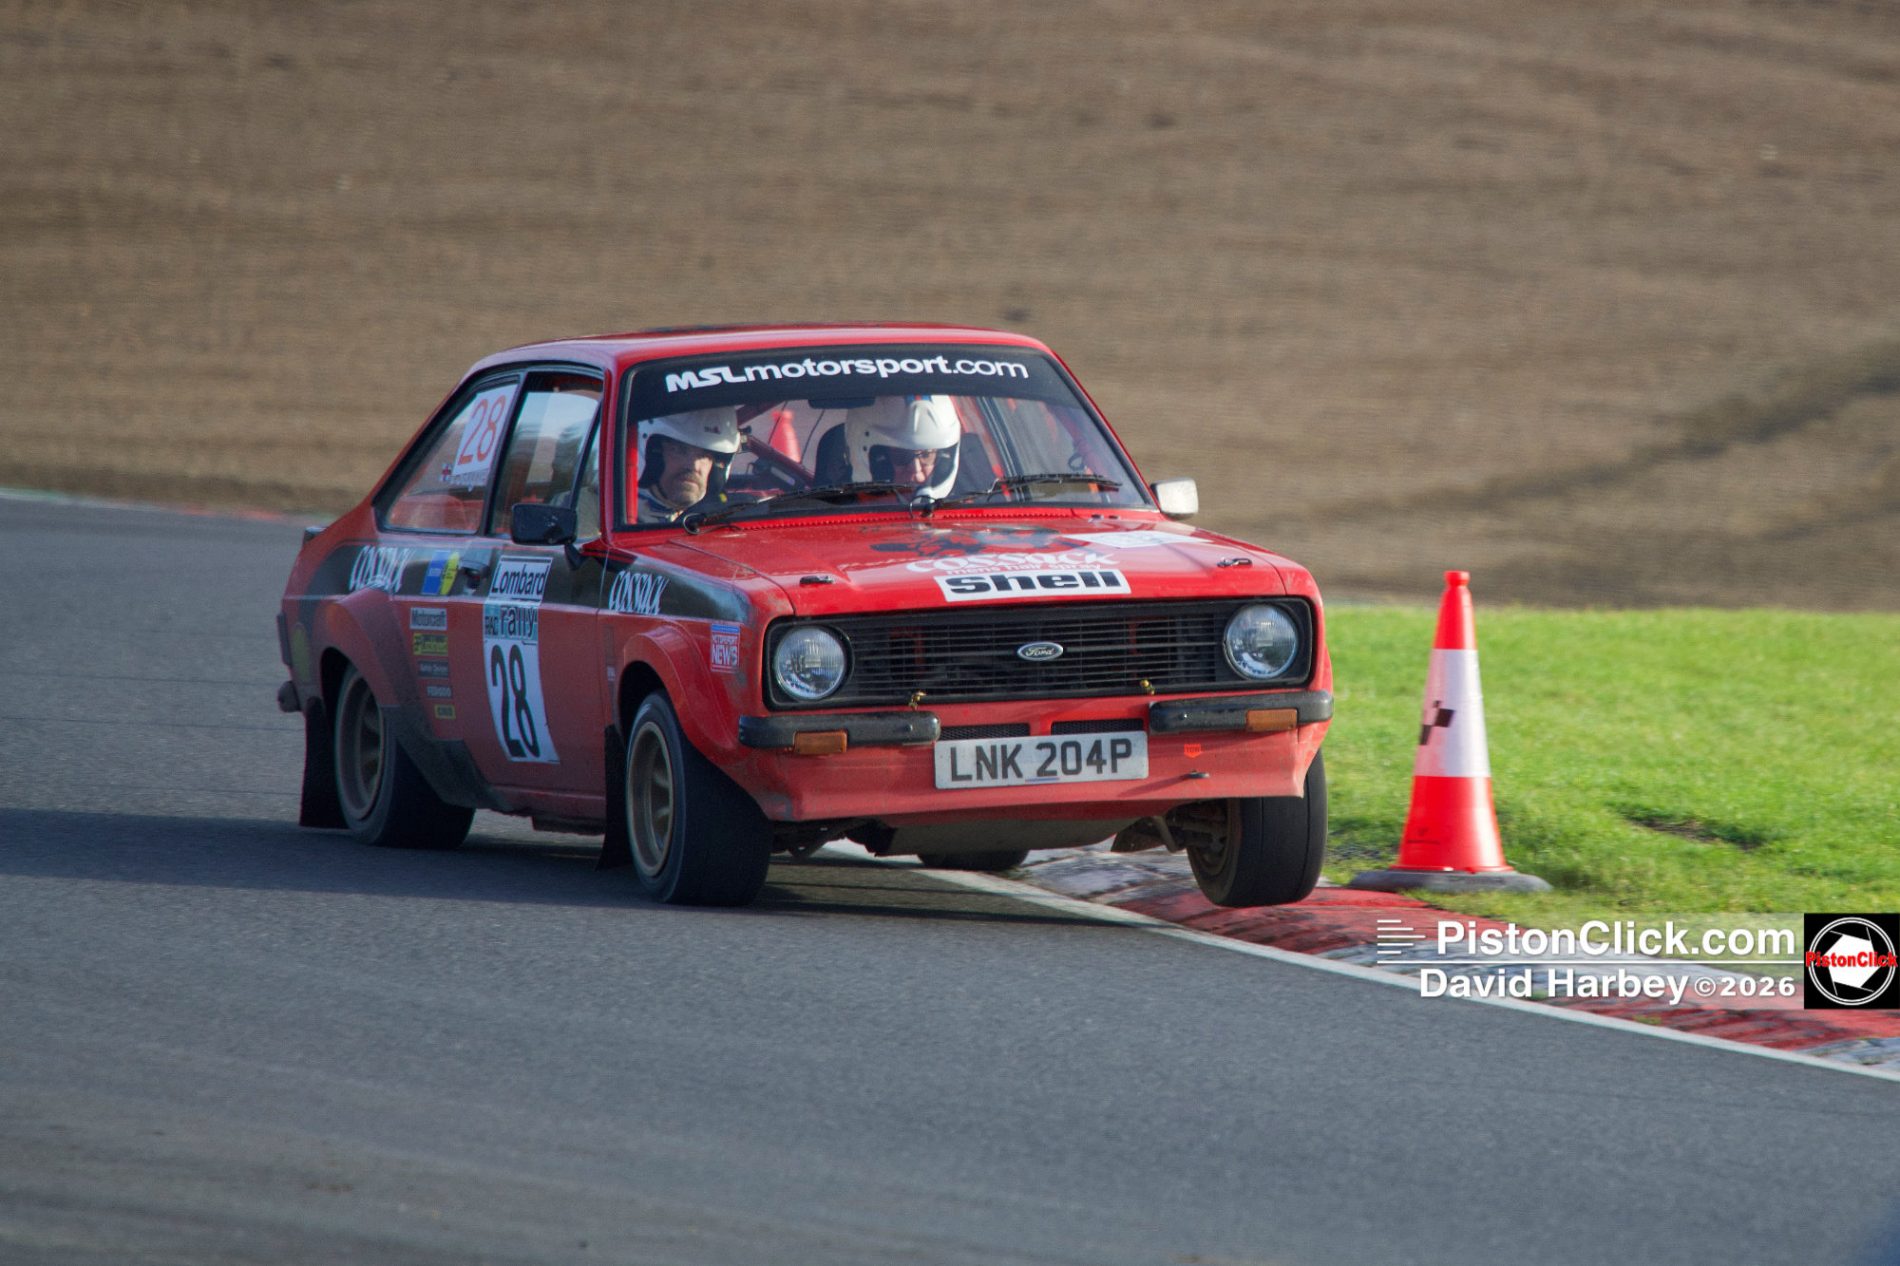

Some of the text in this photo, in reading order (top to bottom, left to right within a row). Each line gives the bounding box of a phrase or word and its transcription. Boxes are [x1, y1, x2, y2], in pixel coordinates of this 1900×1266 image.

[665, 355, 1030, 393] MSLmotorsport.com
[457, 394, 506, 466] 28
[491, 564, 550, 595] Lombard
[1005, 563, 1041, 571] hair
[1048, 563, 1101, 571] spray
[608, 569, 669, 615] COSSACK
[501, 606, 534, 638] rally
[712, 645, 738, 667] NEWS
[1026, 646, 1055, 657] Ford
[491, 644, 541, 758] 28
[950, 738, 1132, 782] LNK 204P
